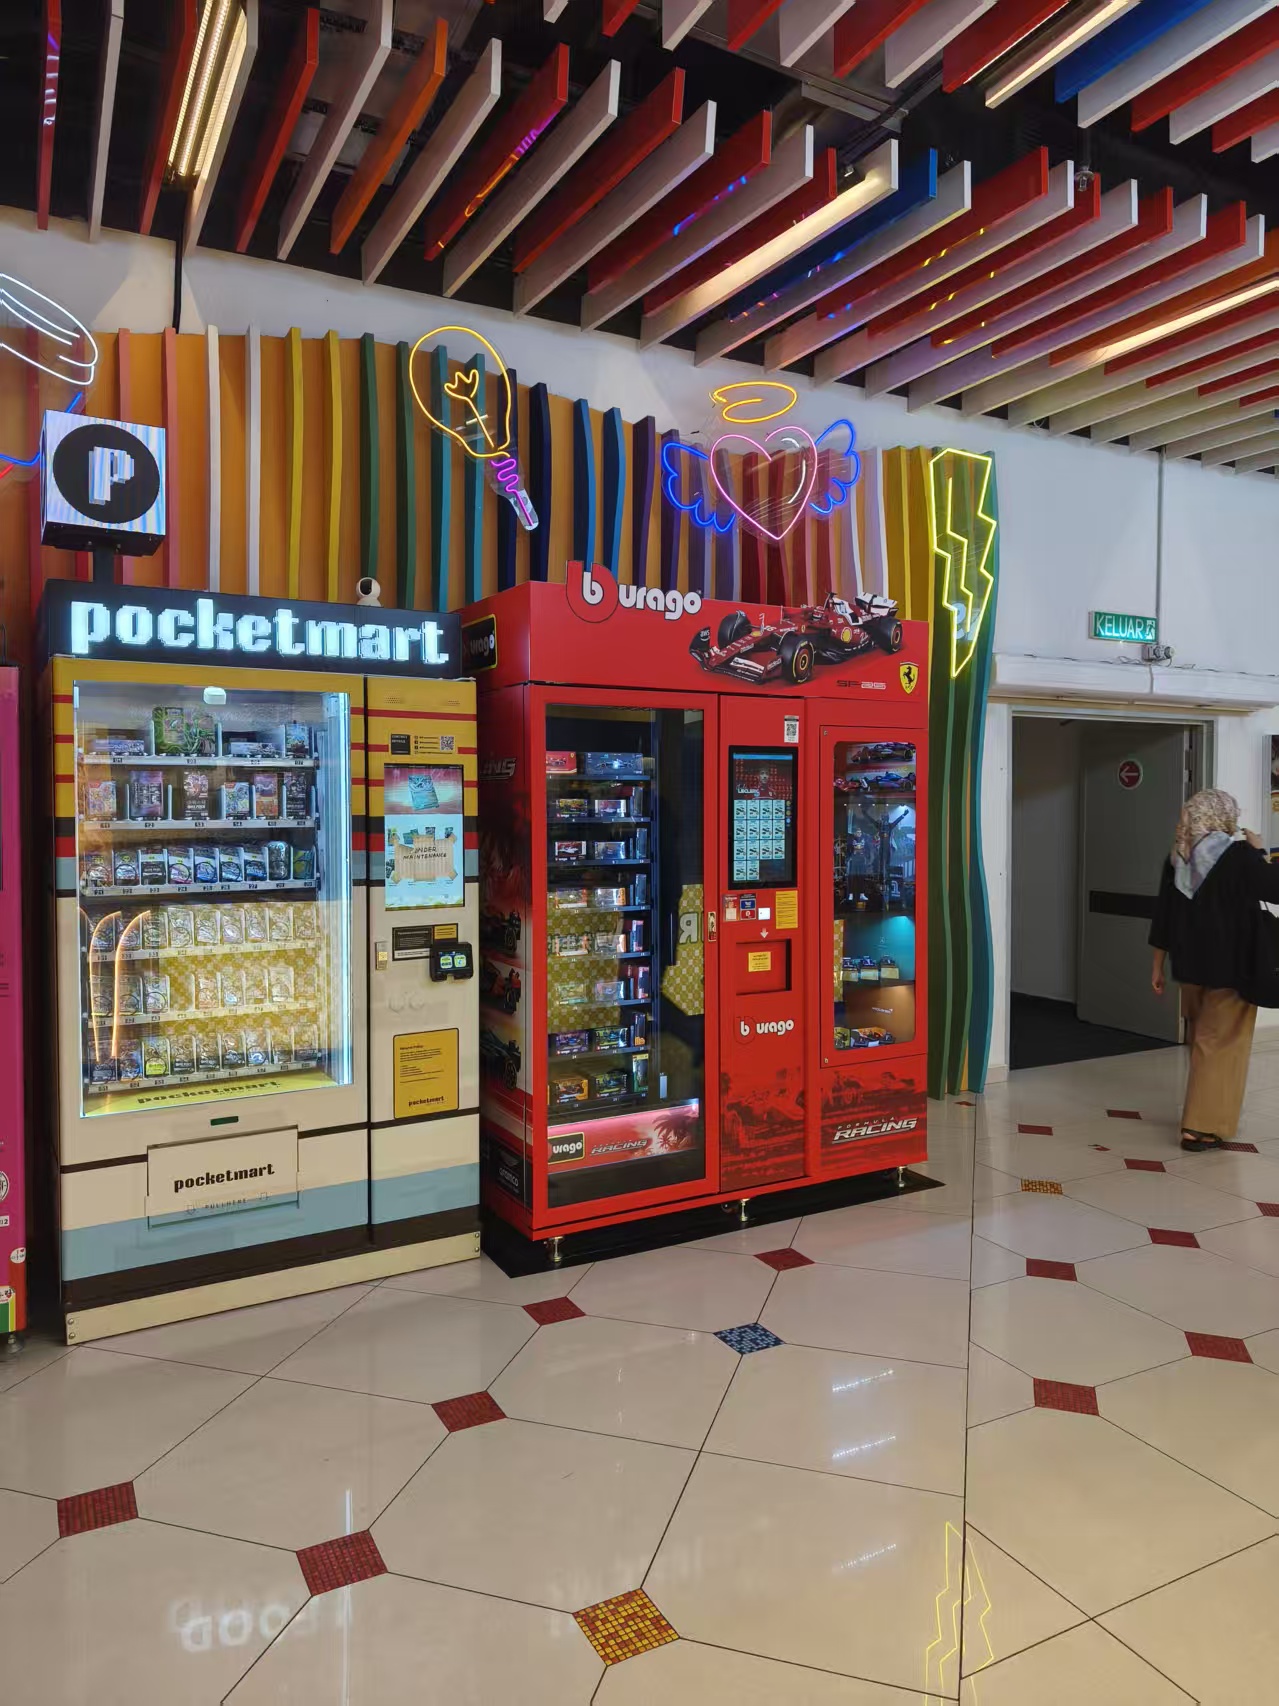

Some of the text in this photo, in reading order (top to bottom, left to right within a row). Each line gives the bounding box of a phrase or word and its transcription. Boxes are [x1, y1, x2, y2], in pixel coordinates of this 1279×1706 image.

[71, 598, 450, 664] pocketmart
[1096, 615, 1144, 639] KELUAR
[403, 852, 447, 860] MAINTENANCE
[833, 1117, 919, 1141] RACING
[174, 1163, 275, 1193] pocketmart
